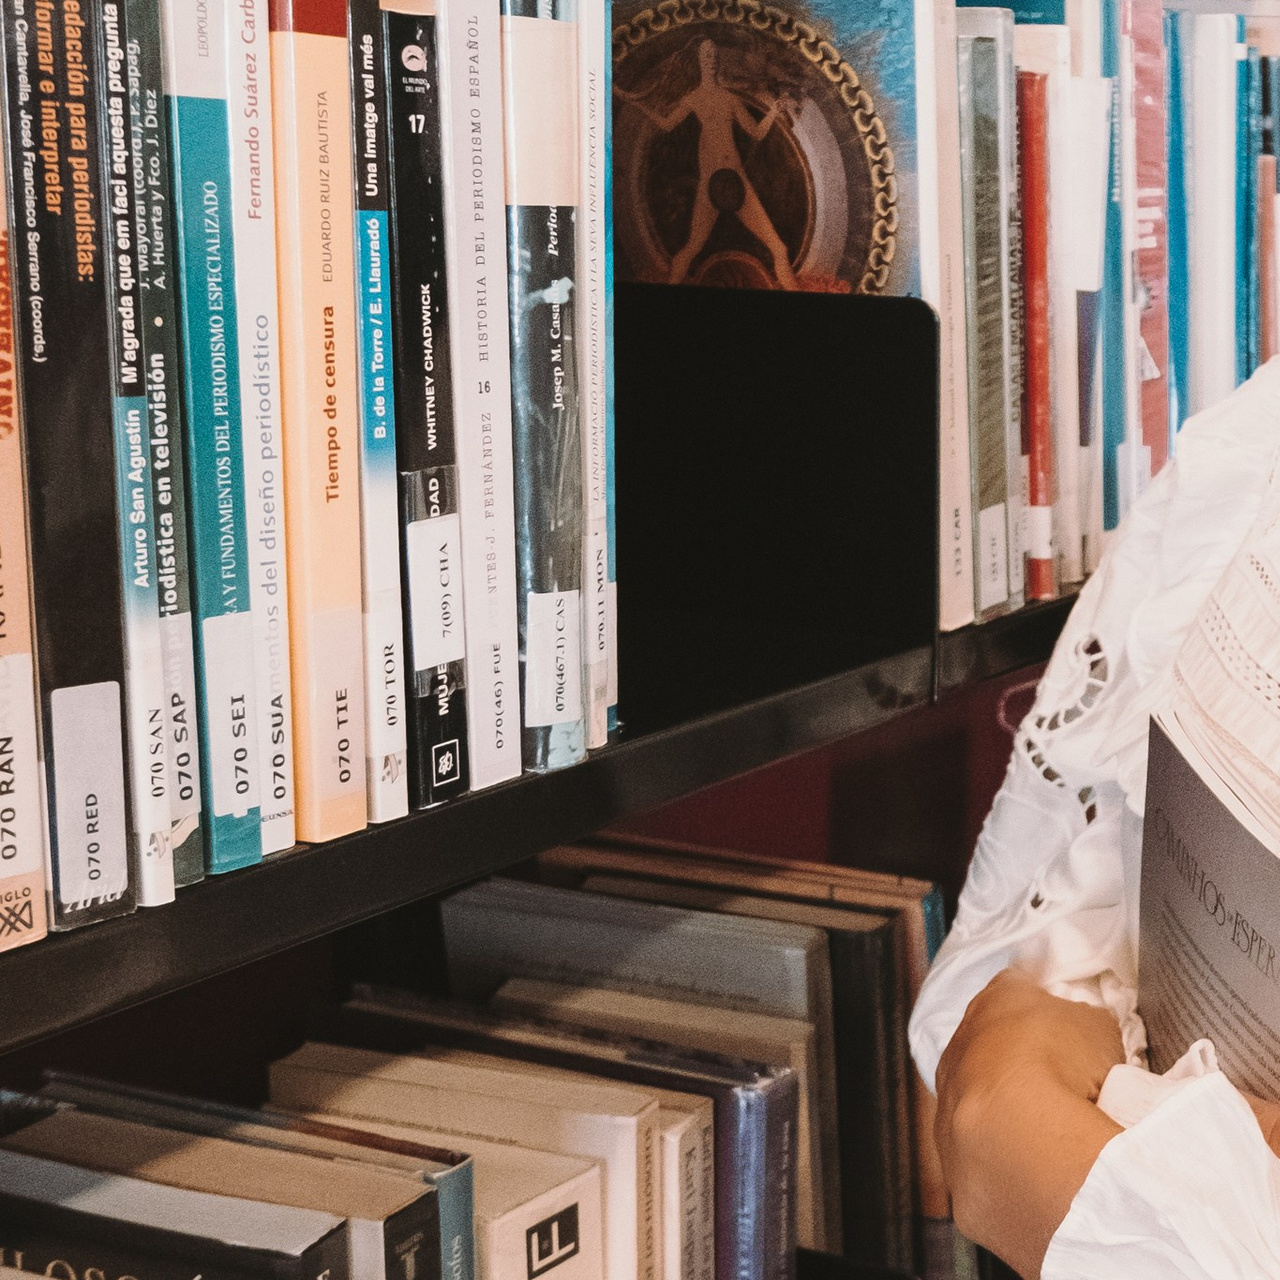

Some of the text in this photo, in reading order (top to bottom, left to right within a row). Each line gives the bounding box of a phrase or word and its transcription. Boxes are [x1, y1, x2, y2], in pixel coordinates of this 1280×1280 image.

[14, 19, 33, 106] Cantavella,
[38, 79, 56, 94] e
[240, 52, 260, 120] Suárez
[20, 109, 35, 148] José
[38, 100, 64, 216] interpretar
[64, 102, 88, 151] para
[359, 34, 379, 197] Una imatge val més
[408, 114, 426, 134] 17
[22, 151, 38, 228] Francisco
[67, 156, 97, 282] periodistas:
[102, 2, 141, 384] M'agrada que em faci aquesta pregunta
[144, 89, 167, 290] A. Huerta y Fco. J. Díez
[244, 125, 262, 220] Fernando
[316, 90, 334, 283] EDUARDO RUIZ BAUTISTA
[465, 15, 489, 362] HISTORIA DEL PERIODISMO ESPAÑOL
[27, 231, 41, 292] Serrano
[202, 180, 225, 312] ESPECIALIZADO
[29, 295, 48, 363] (coords.)
[209, 315, 230, 417] PERIODISMO
[365, 217, 386, 439] B. de la Torre E. Llauradó
[420, 283, 438, 451] WHITNEY CHADWICK
[551, 343, 566, 411] Josep M.
[147, 353, 173, 506] en televisión
[213, 419, 231, 453] DEL
[321, 305, 342, 504] Tiempo de censura
[478, 380, 491, 394] 16
[124, 409, 150, 588] Arturo San Agustín
[252, 314, 278, 596] del diseño periodístico
[481, 412, 495, 520] FERNÁNDEZ
[216, 455, 237, 580] FUNDAMENTOS
[222, 582, 238, 597] Y
[596, 548, 605, 595] MON
[383, 642, 399, 726] 070 TOR
[492, 642, 505, 749] 070(46) FUE
[555, 597, 567, 712] 070(467.1) CAS
[148, 707, 166, 798] 070 SAN
[170, 692, 194, 801] 070 SAP
[230, 693, 250, 795] 070 SEI
[270, 693, 287, 800] 070 SUA
[335, 687, 352, 784] 070 TIE
[0, 735, 17, 861] 070 RAN
[85, 792, 101, 881] 070 RED
